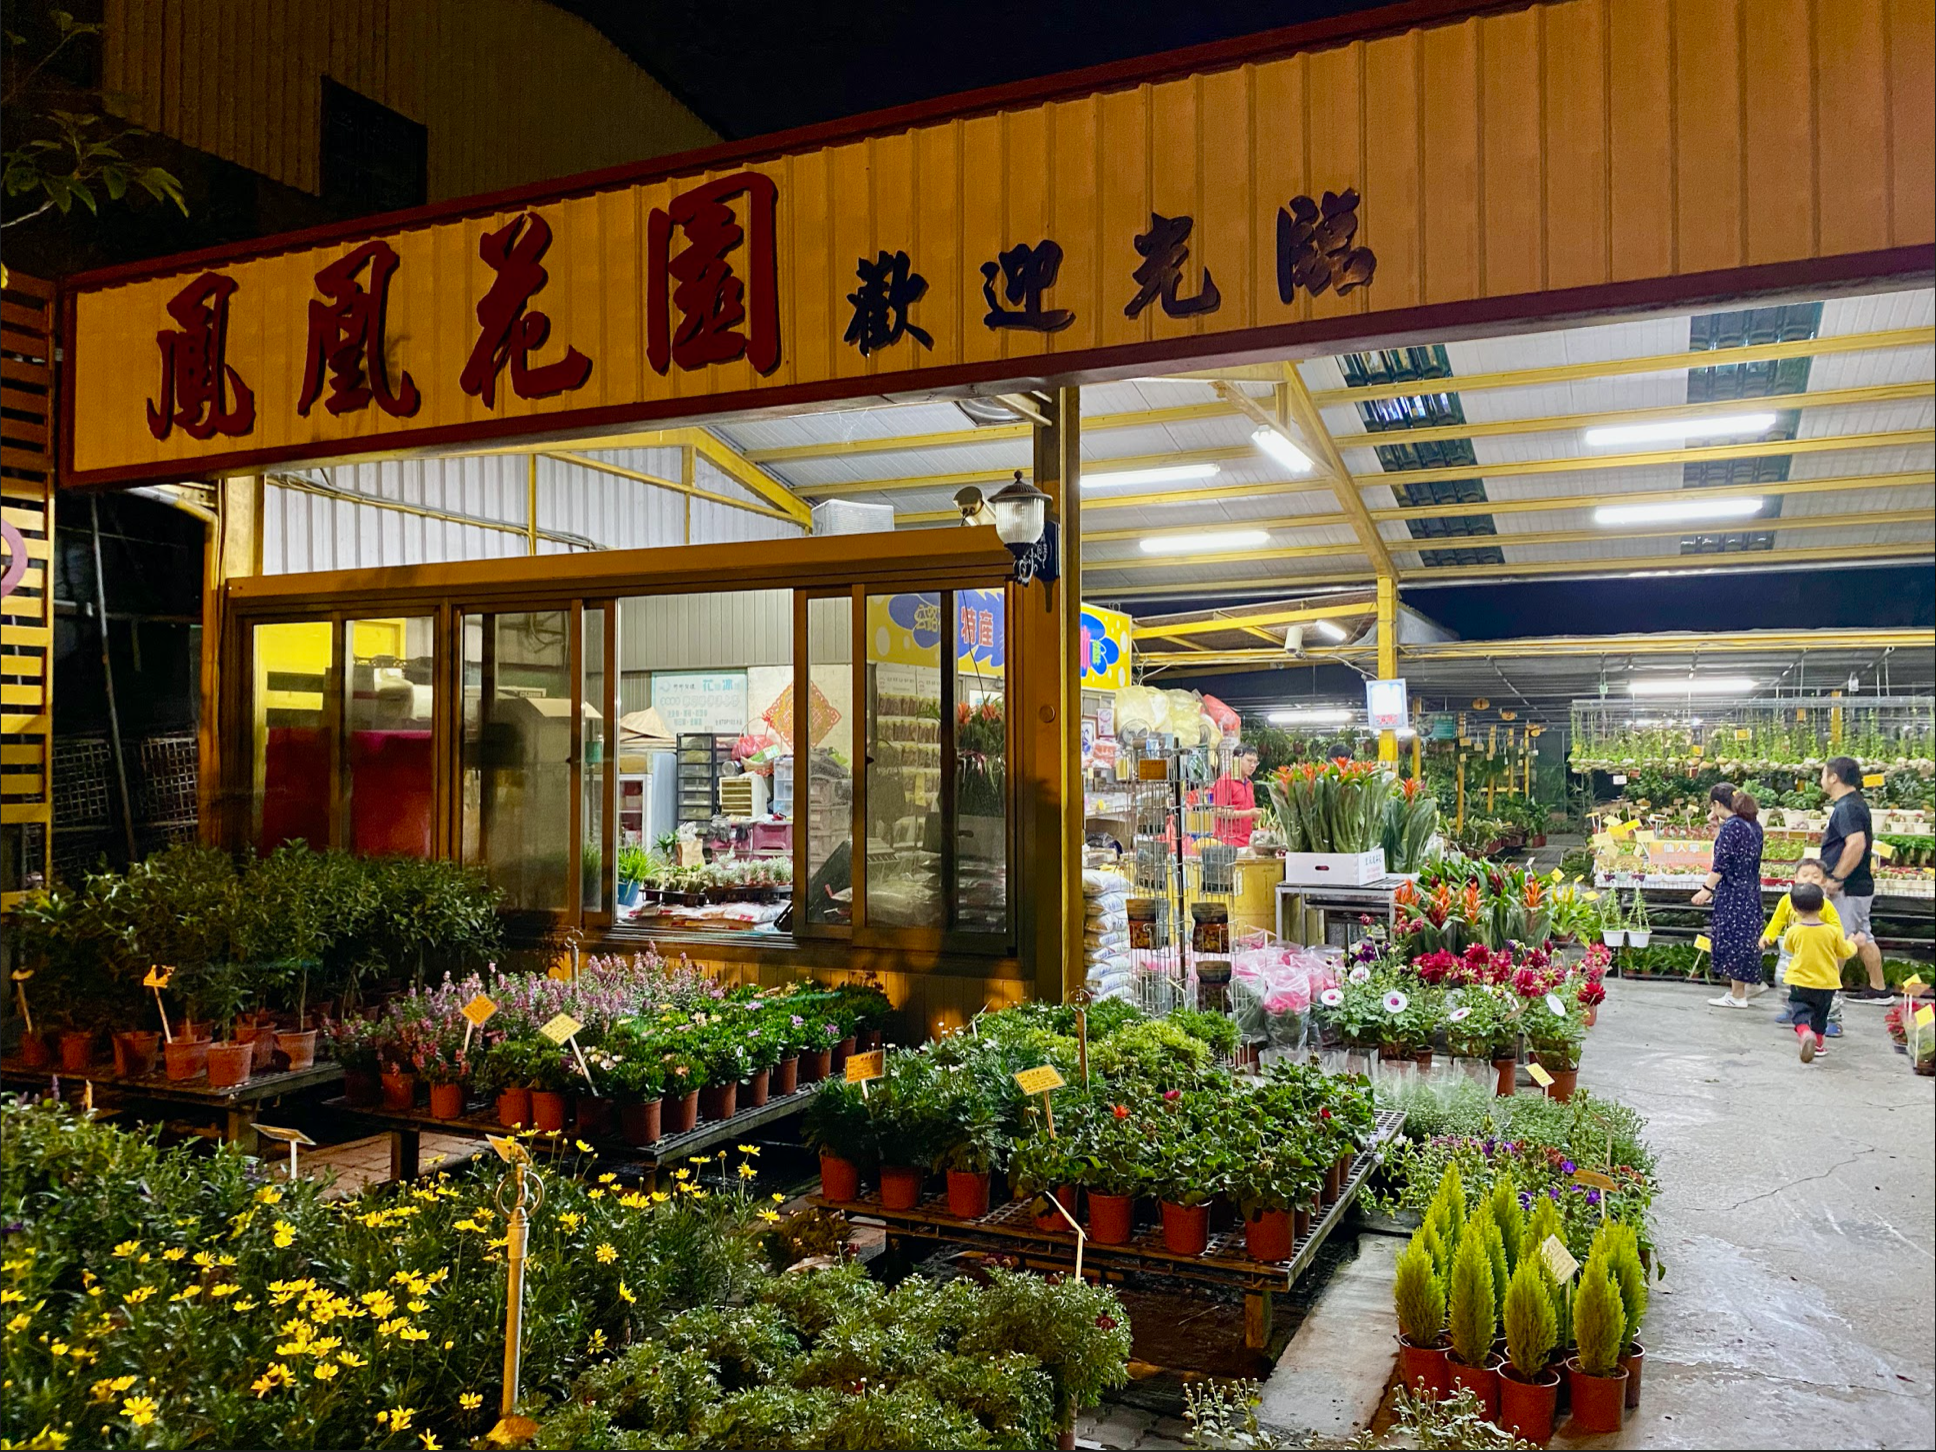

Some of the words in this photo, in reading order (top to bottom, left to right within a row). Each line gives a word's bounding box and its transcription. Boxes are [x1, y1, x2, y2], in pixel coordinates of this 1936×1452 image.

[147, 171, 782, 440] 鳳凰花園
[843, 187, 1378, 357] 歡迎光臨
